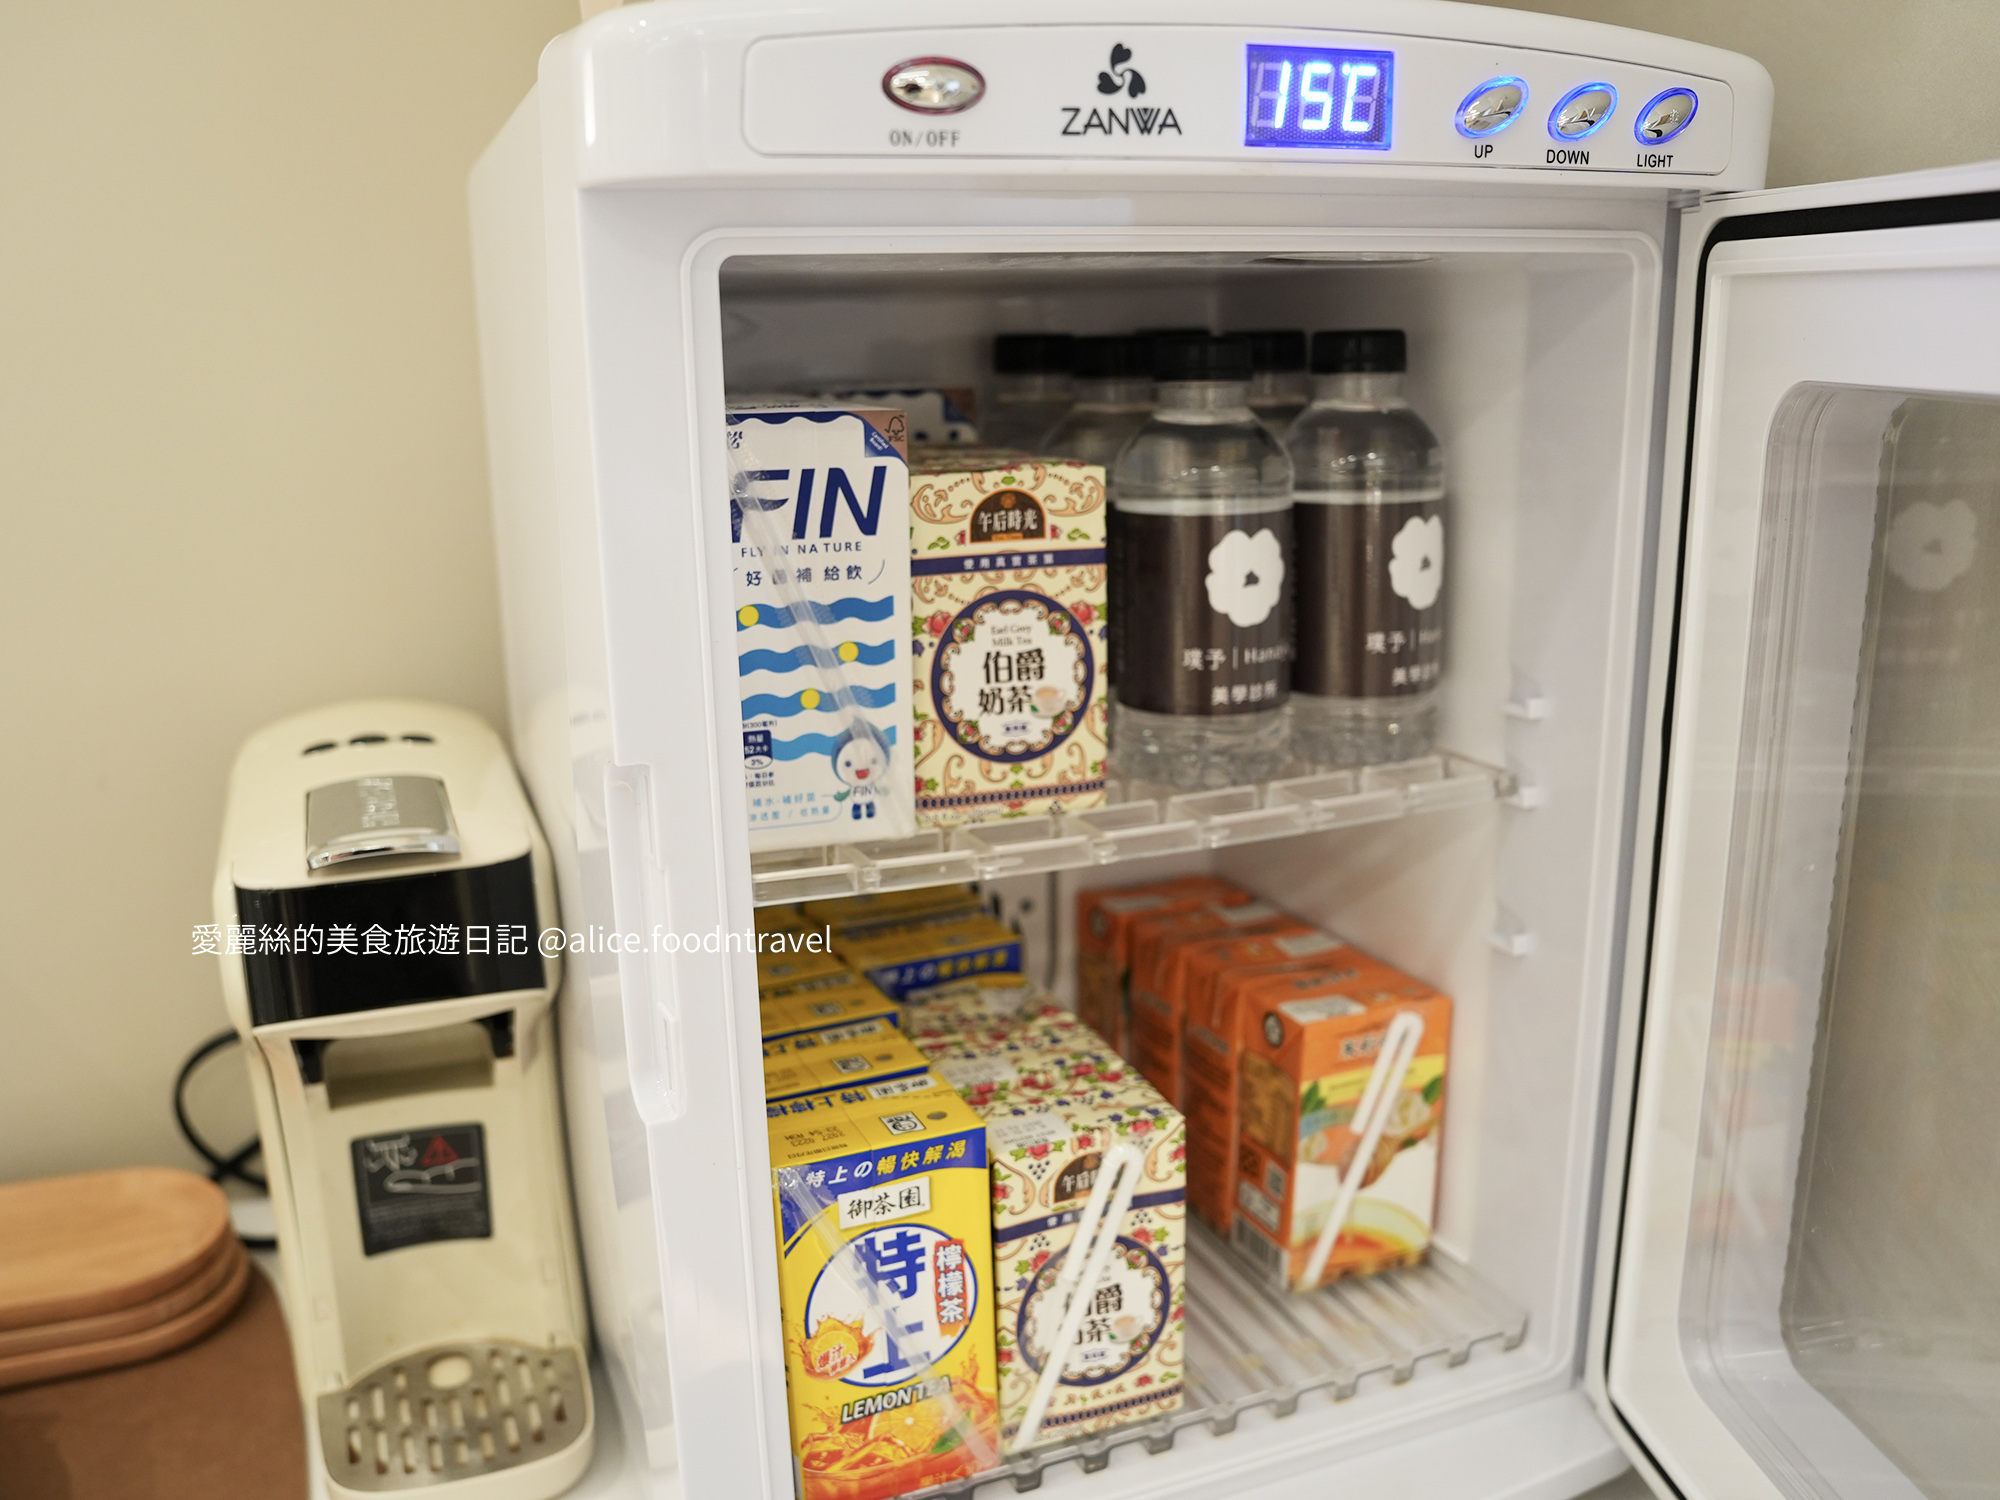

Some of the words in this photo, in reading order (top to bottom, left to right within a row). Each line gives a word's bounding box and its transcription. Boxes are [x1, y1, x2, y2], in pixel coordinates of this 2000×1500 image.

[1061, 107, 1182, 135] ZANWA
[889, 129, 961, 147] ON/OFF
[1474, 144, 1493, 159] UP
[1546, 149, 1590, 165] DOWN
[1636, 153, 1674, 168] LIGHT
[730, 465, 887, 543] FIN
[978, 508, 1038, 534] 午后時光
[774, 545, 789, 556] N
[798, 541, 862, 554] NATURE
[992, 637, 1014, 647] Milk
[983, 648, 1044, 684] 伯爵
[978, 685, 1033, 716] 奶茶
[852, 786, 872, 796] FIN
[1062, 1169, 1099, 1193] 午后
[848, 1186, 921, 1220] 御茶園
[936, 1244, 965, 1324] 檸檬茶
[855, 1230, 931, 1379] 特上
[841, 1386, 914, 1424] LEMON
